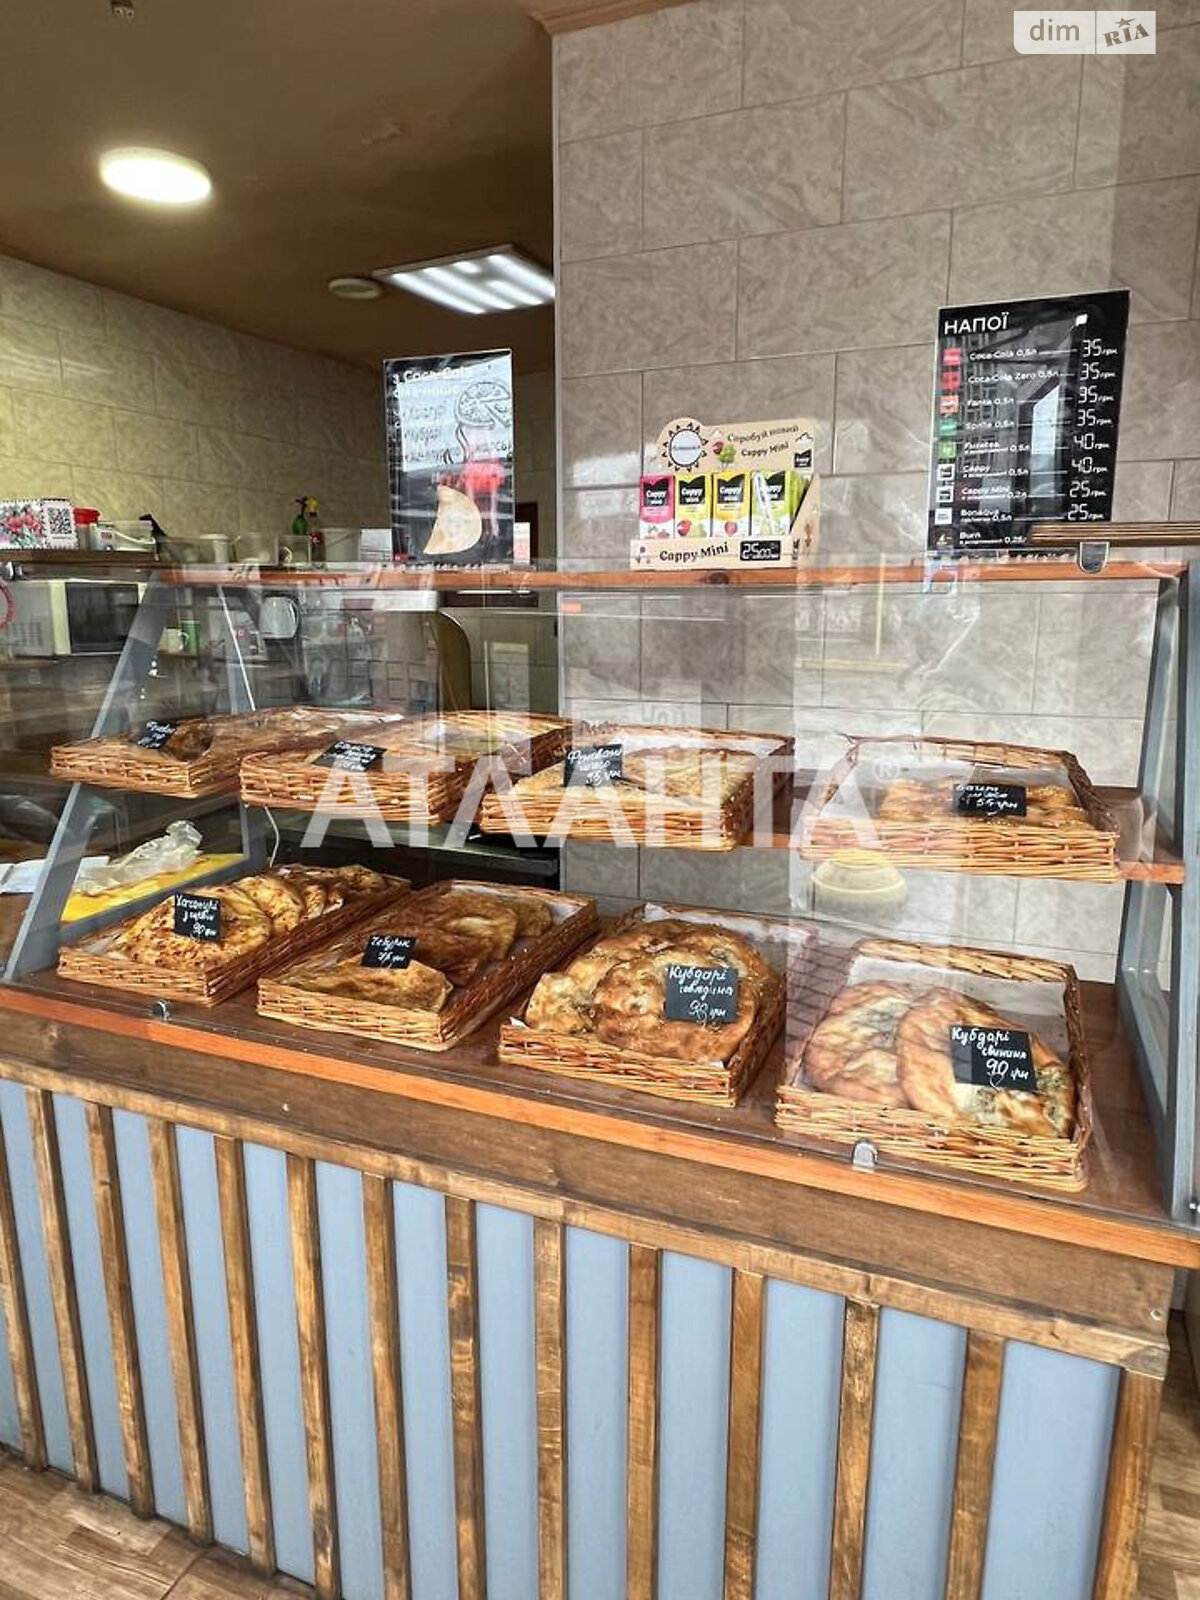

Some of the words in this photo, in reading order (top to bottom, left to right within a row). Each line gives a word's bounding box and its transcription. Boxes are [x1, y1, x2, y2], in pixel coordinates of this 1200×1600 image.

[944, 311, 1009, 334] НАПОЇ
[1082, 338, 1101, 357] 35
[1080, 362, 1100, 380] 35
[1078, 385, 1098, 403] 35
[1077, 408, 1096, 426] 35
[741, 448, 768, 457] Cappy
[769, 441, 789, 453] Mini
[1073, 433, 1094, 450] 40
[1071, 456, 1092, 474] 40
[1069, 480, 1090, 498] 25
[1067, 503, 1088, 521] 25
[659, 550, 698, 562] Cappy
[700, 541, 729, 558] Mini
[669, 966, 727, 985] Кубдарі
[951, 1027, 1012, 1049] Кубдарі
[986, 1058, 1009, 1076] 90
